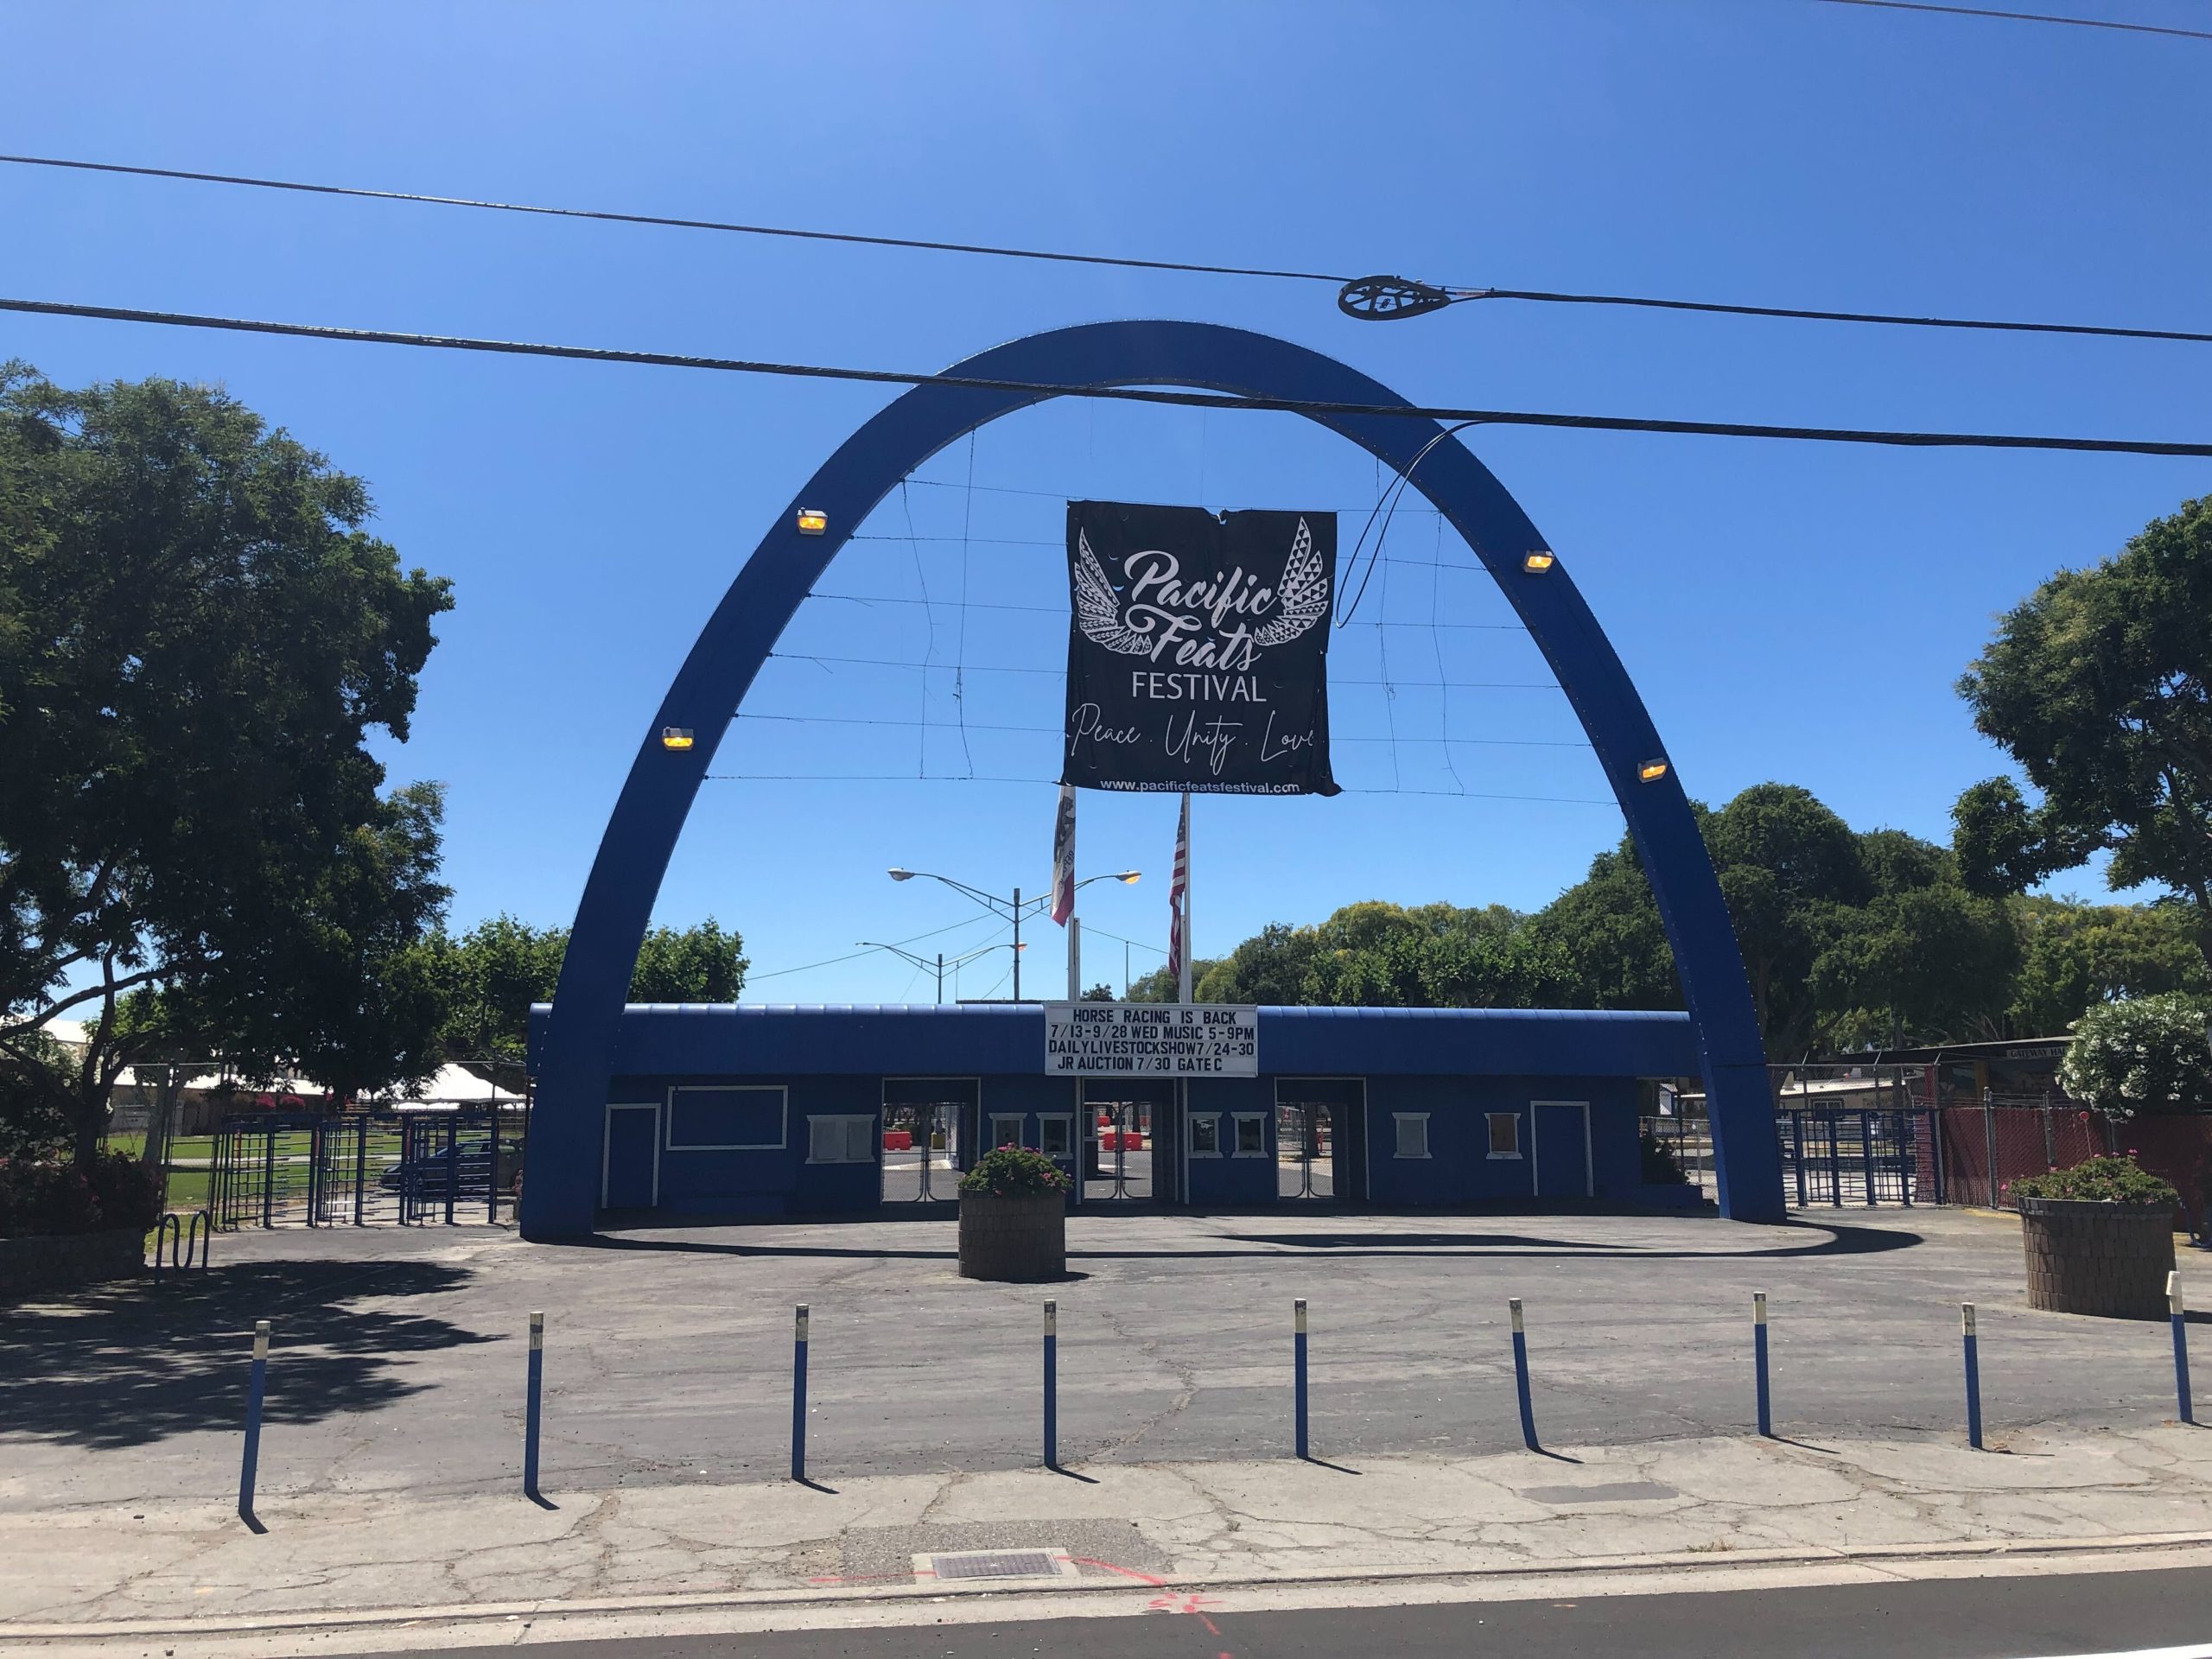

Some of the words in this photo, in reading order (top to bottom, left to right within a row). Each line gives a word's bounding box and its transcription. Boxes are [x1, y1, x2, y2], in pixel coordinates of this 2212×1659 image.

[1123, 550, 1277, 628] Pacific
[1124, 603, 1262, 671] Feats
[1132, 671, 1267, 702] FESTIVAL
[1071, 702, 1141, 758] Peace
[1165, 709, 1244, 776] Unity
[1099, 779, 1300, 795] www.pacificfeatsfestival.com
[1073, 1009, 1114, 1023] HORSE
[1123, 1010, 1171, 1024] RACING
[1180, 1011, 1193, 1024] IS
[1203, 1012, 1236, 1025] BACK
[1051, 1025, 1128, 1039] 7/13-9/28
[1131, 1026, 1160, 1039] WED
[1163, 1026, 1204, 1040] MUSIC
[1209, 1027, 1255, 1040] 5-9PM
[1058, 1057, 1074, 1070] JR
[1077, 1057, 1134, 1071] AUCTION
[1136, 1057, 1171, 1071] 7/30
